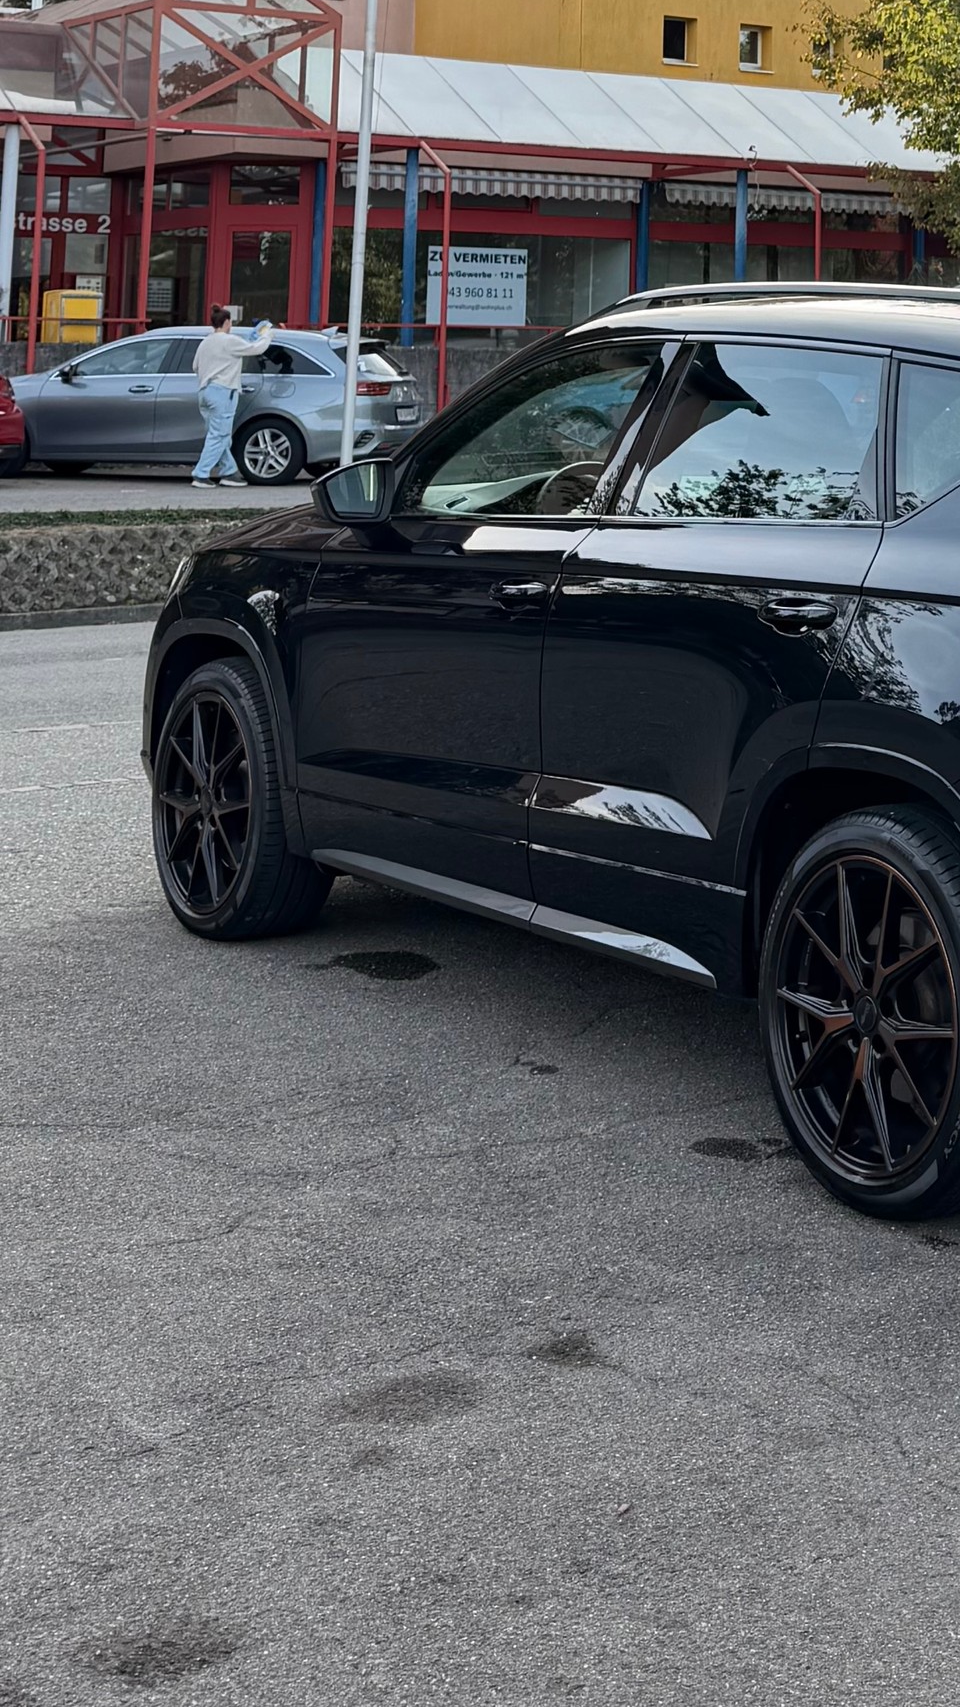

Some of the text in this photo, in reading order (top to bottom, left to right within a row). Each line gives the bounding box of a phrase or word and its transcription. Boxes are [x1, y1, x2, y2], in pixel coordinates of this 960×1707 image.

[14, 212, 111, 233] trasse 2
[453, 251, 527, 265] VERMIETEN
[500, 271, 514, 279] 121
[464, 287, 484, 298] 960
[486, 287, 498, 299] 81
[502, 288, 514, 299] 11
